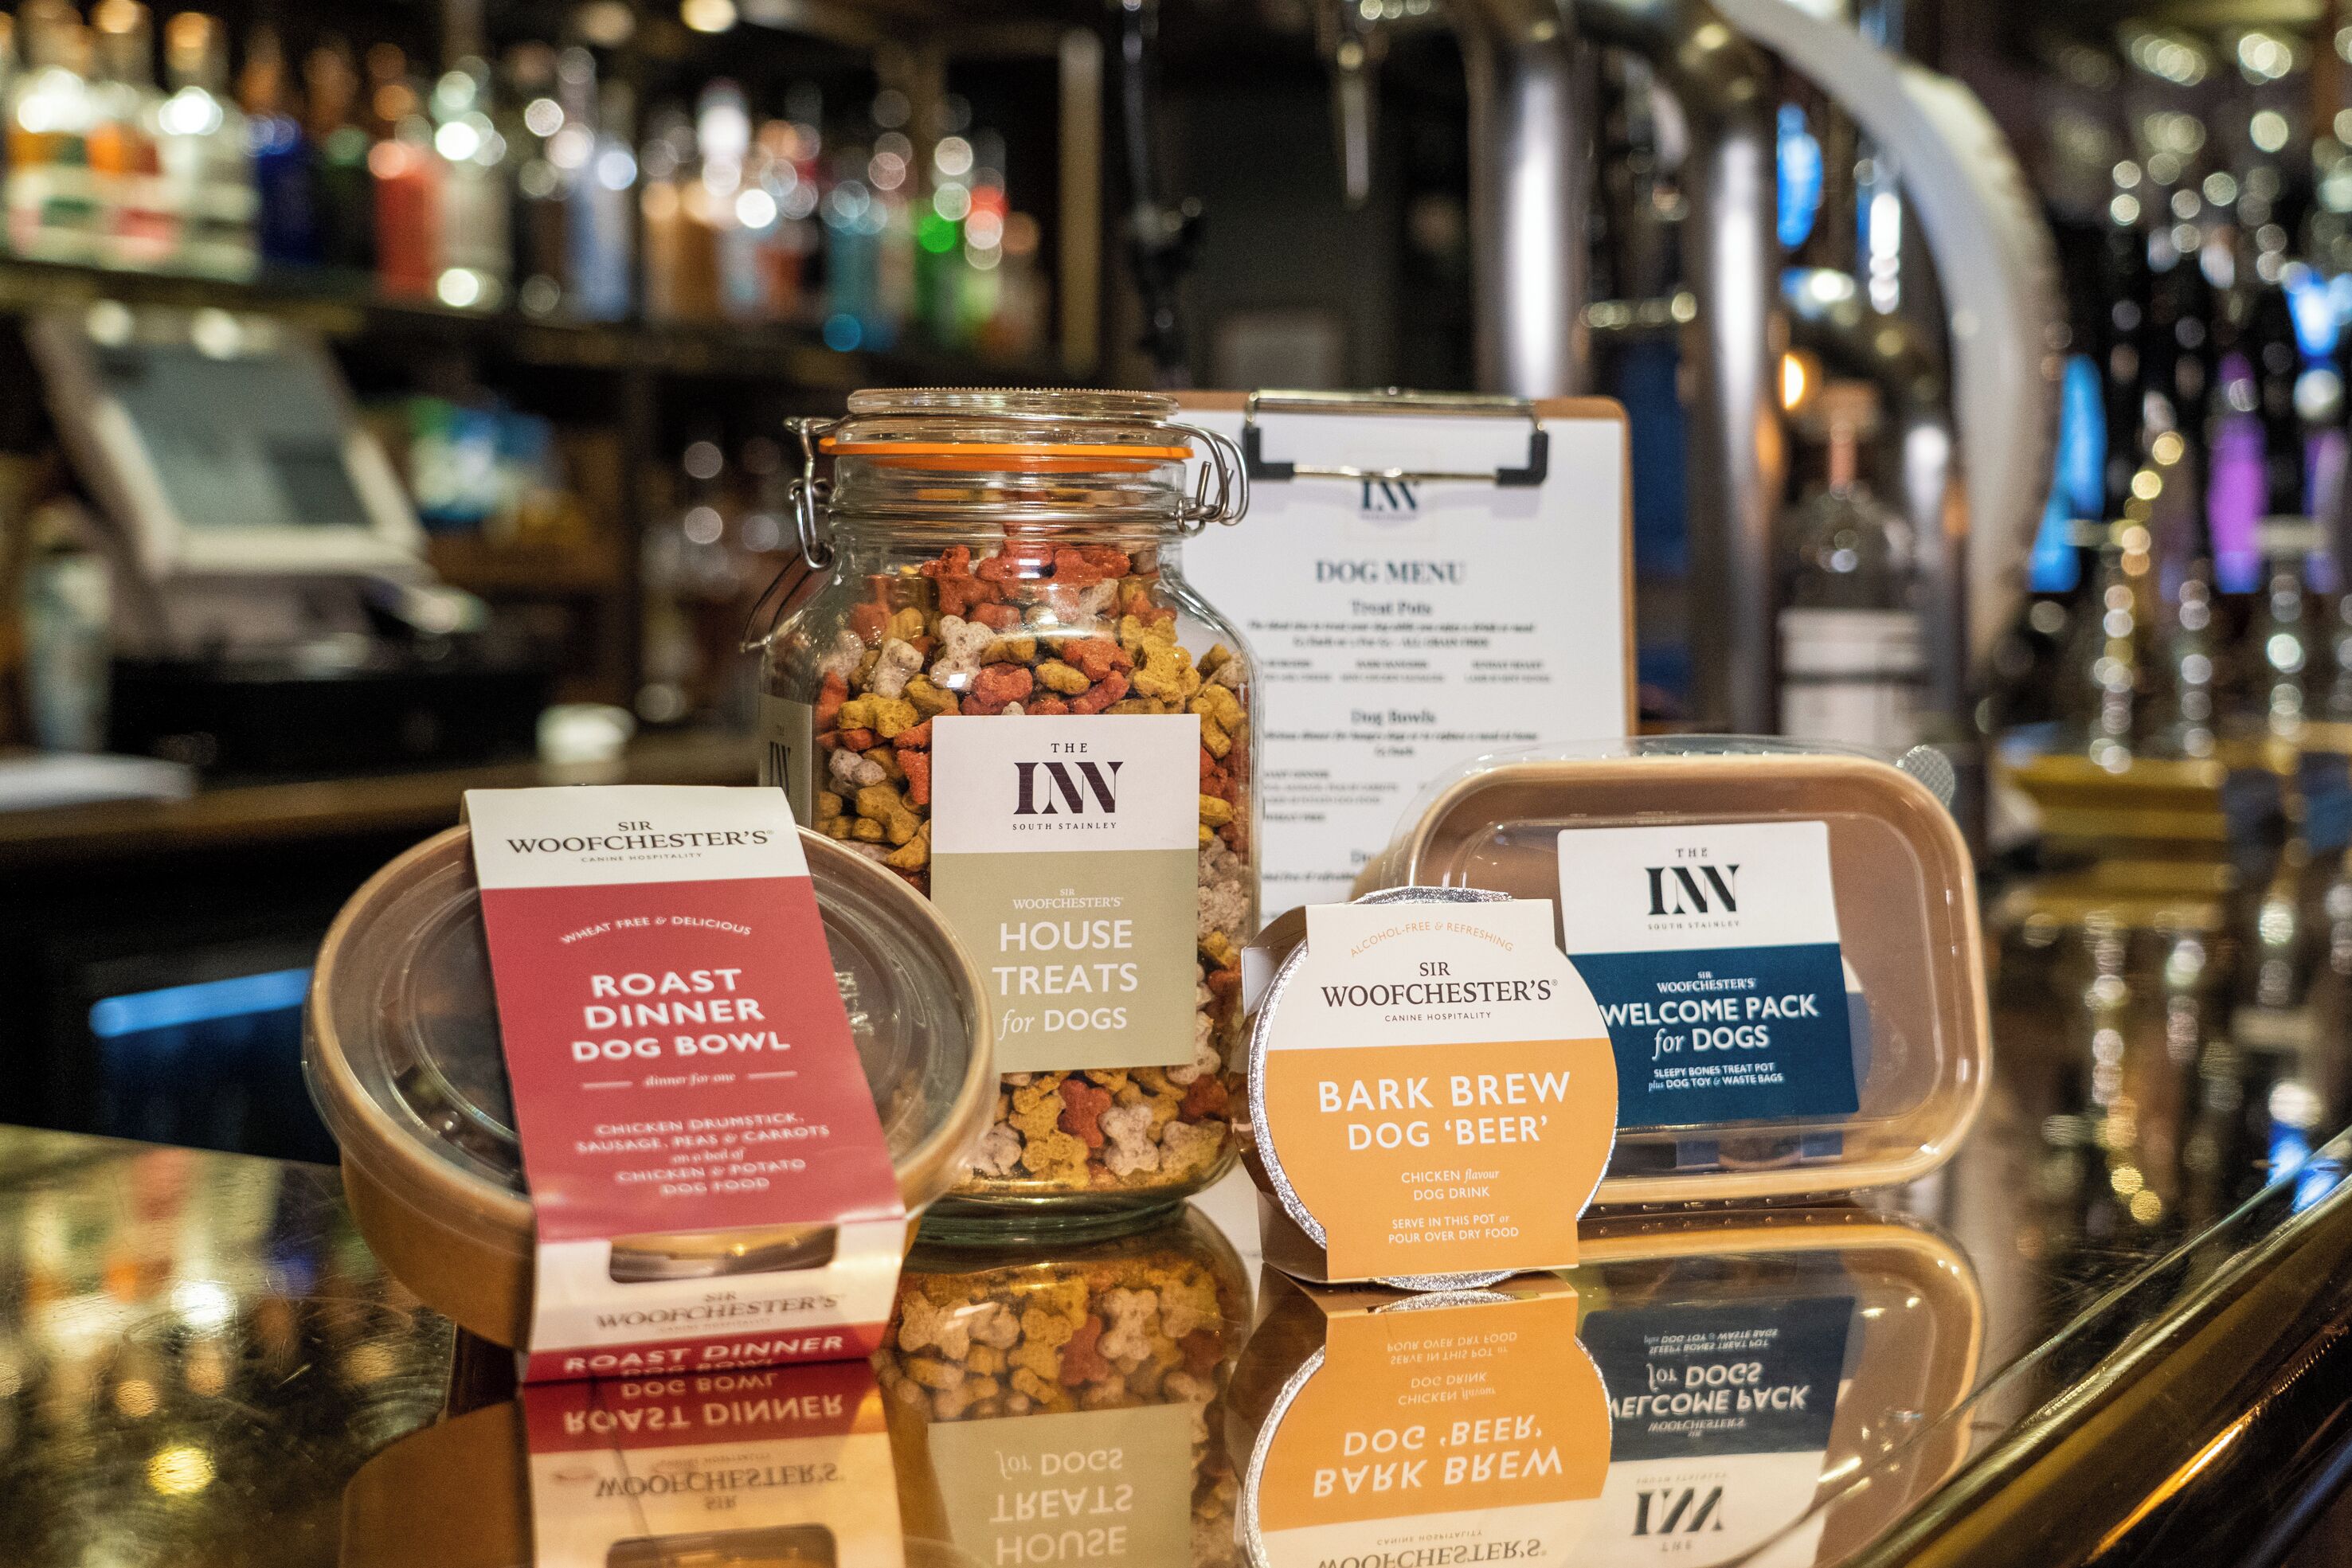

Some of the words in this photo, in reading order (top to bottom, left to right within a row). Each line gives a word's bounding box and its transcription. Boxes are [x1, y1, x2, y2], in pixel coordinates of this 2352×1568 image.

[1316, 560, 1378, 583] DOG
[1386, 560, 1466, 584] MENU
[1352, 711, 1383, 725] Dog
[1389, 711, 1436, 724] Bowls
[1051, 743, 1088, 753] THE
[1013, 761, 1123, 814] INN
[619, 821, 652, 831] SIR
[581, 854, 624, 863] CANINE
[1676, 848, 1708, 858] THE
[1645, 864, 1740, 915] INN
[561, 923, 611, 944] WHEAT
[616, 917, 649, 929] FREE
[672, 916, 752, 936] DELICIOUS
[1000, 920, 1133, 952] HOUSE
[1351, 921, 1431, 958] ALCOHOL-FREE
[1434, 921, 1443, 931] &
[1446, 923, 1514, 952] REFRESHING
[992, 963, 1138, 995] TREATS
[1419, 961, 1450, 976] SIR
[591, 969, 742, 998] ROAST
[584, 998, 764, 1030] DINNER
[1427, 1012, 1491, 1021] HOSPITALITY
[1599, 998, 1739, 1026] WELCOME
[1746, 994, 1819, 1019] PACK
[999, 1009, 1034, 1040] for
[1044, 1007, 1127, 1032] DOGS
[572, 1037, 661, 1062] DOG
[676, 1031, 790, 1056] BOWL
[1652, 1028, 1685, 1061] for
[1692, 1026, 1770, 1051] DOGS
[644, 1076, 687, 1087] dinner
[691, 1073, 708, 1085] for
[714, 1073, 735, 1083] one
[1653, 1067, 1685, 1078] SLEEPY
[1689, 1066, 1720, 1076] BONES
[1722, 1064, 1752, 1074] TREAT
[1755, 1062, 1775, 1072] POT
[1318, 1077, 1434, 1112] BARK
[1450, 1072, 1570, 1107] BREW
[1648, 1080, 1664, 1093] plus
[1666, 1078, 1689, 1088] DOG
[1692, 1077, 1712, 1087] TOY
[1722, 1075, 1756, 1085] WASTE
[1758, 1073, 1784, 1084] BAGS
[595, 1121, 683, 1136] CHICKEN
[672, 1134, 718, 1148] PEAS
[742, 1125, 829, 1143] CARROTS
[1348, 1121, 1430, 1150] DOG
[616, 1167, 705, 1183] CHICKEN
[730, 1159, 806, 1175] POTATO
[1401, 1170, 1461, 1183] CHICKEN
[1465, 1168, 1500, 1182] flavour
[659, 1183, 707, 1196] DOG
[716, 1178, 769, 1191] FOOD
[1414, 1189, 1444, 1201] DOG
[1449, 1187, 1490, 1198] DRINK
[1392, 1217, 1425, 1229] SERVE
[1428, 1217, 1441, 1226] IN
[1443, 1215, 1470, 1226] THIS
[1473, 1214, 1495, 1224] POT
[1388, 1232, 1420, 1244] POUR
[1424, 1230, 1455, 1241] OVER
[1458, 1230, 1481, 1240] DRY
[1485, 1227, 1519, 1238] FOOD
[703, 1291, 736, 1302] SIR
[565, 1348, 692, 1373] ROAST
[702, 1335, 844, 1359] DINNER
